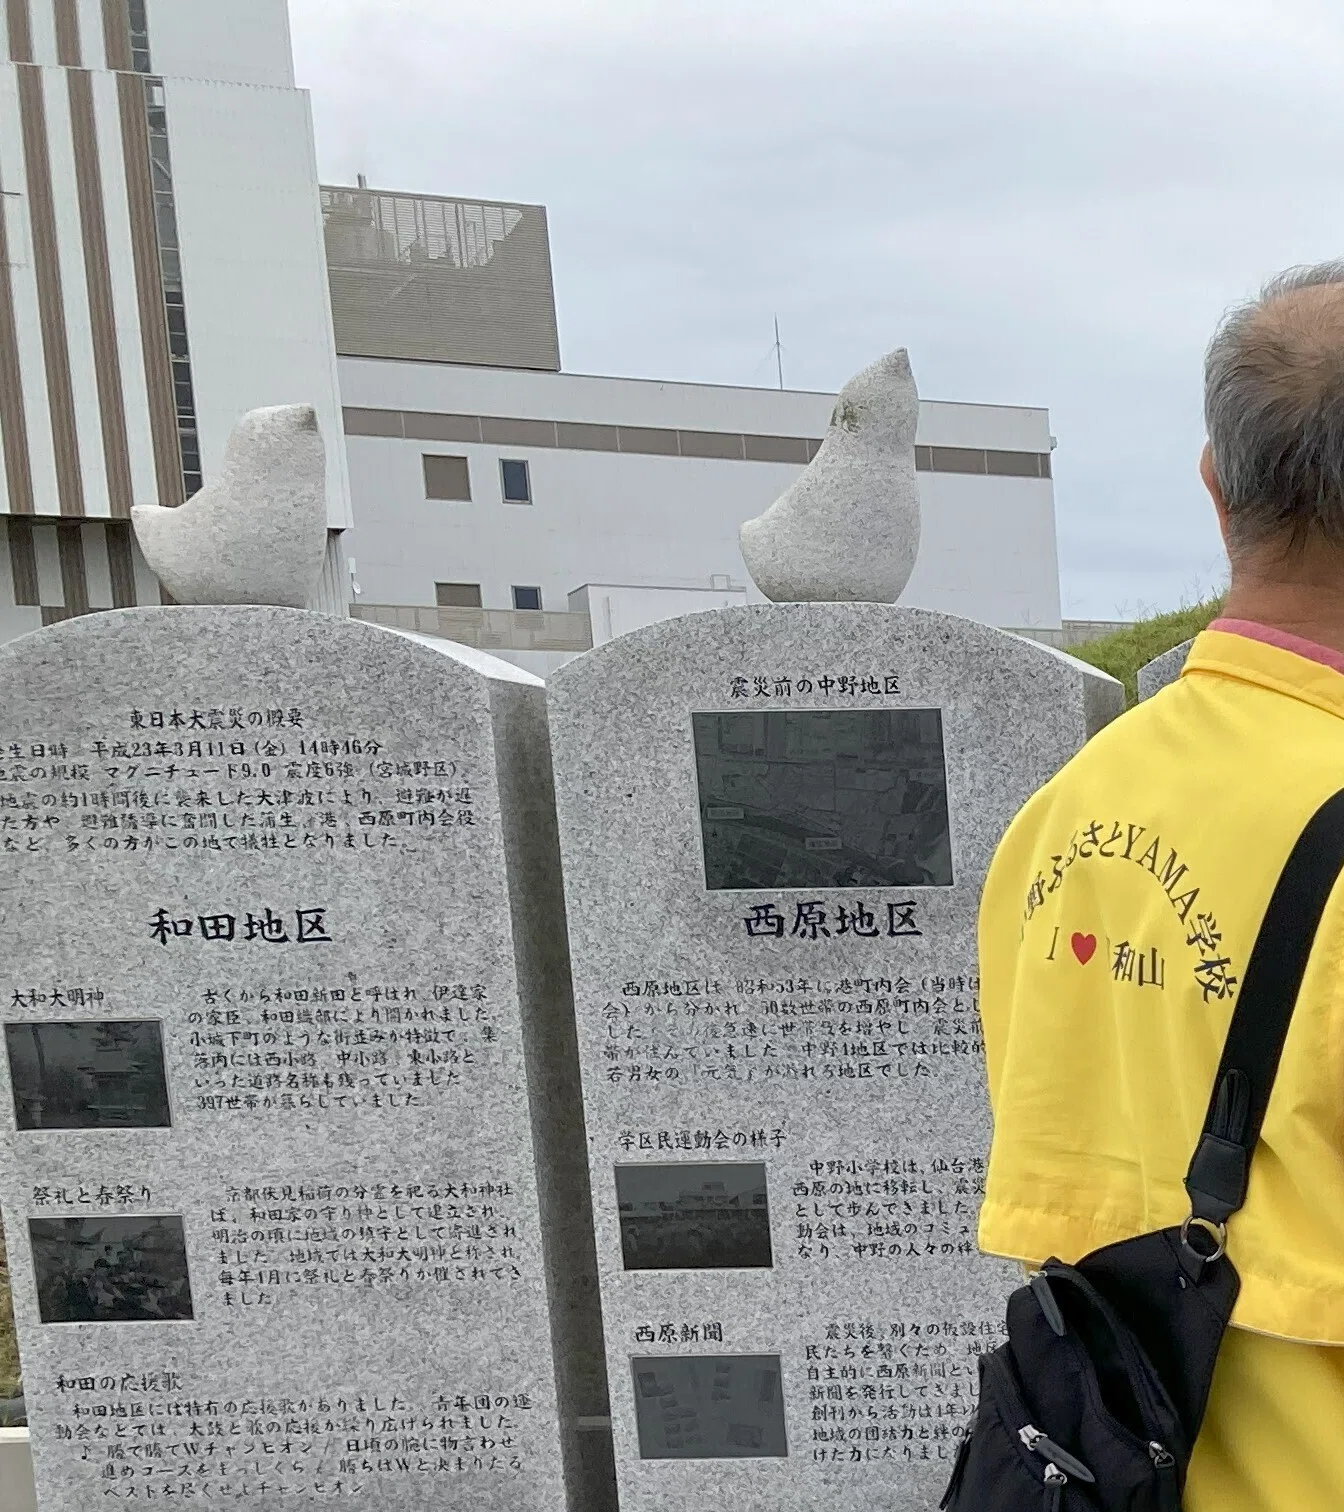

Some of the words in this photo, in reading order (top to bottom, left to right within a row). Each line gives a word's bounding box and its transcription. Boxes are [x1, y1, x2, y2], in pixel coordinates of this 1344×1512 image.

[730, 674, 901, 698] 震災前の中野地区
[130, 708, 305, 730] 東日本大震災の概要
[0, 743, 68, 760] 生日時
[0, 764, 90, 783] 震の規模
[149, 907, 333, 945] 和田地区
[744, 900, 923, 941] 西原地区
[10, 988, 105, 1008] 大和大明神
[618, 1129, 788, 1151] 学区民運動会の様子
[33, 1185, 152, 1205] 祭礼と春祭り
[635, 1322, 723, 1343] 西原新聞
[56, 1373, 183, 1393] 和田の応援歌
